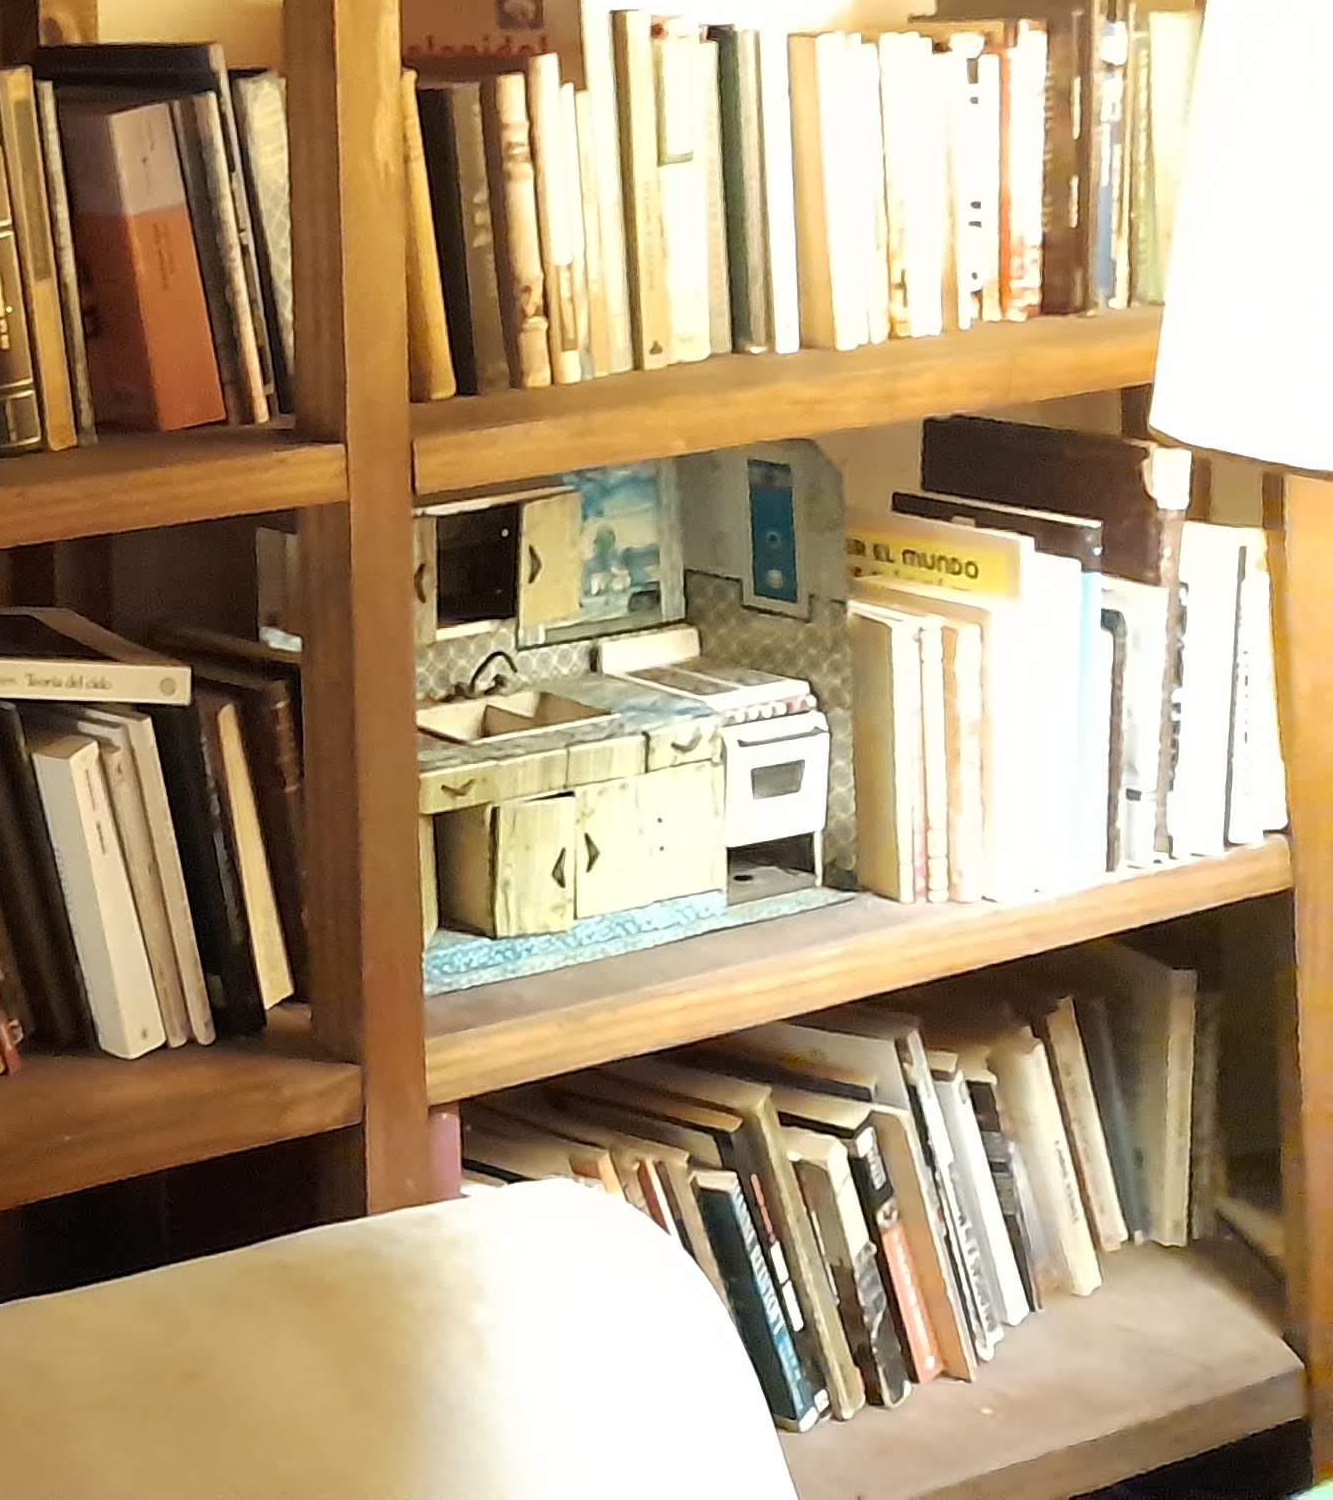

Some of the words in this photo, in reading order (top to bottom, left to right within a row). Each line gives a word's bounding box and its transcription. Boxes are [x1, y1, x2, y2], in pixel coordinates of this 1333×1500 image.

[873, 543, 895, 563] EL
[902, 548, 980, 580] MUNDO
[26, 673, 62, 687] Teoría
[64, 674, 83, 688] del
